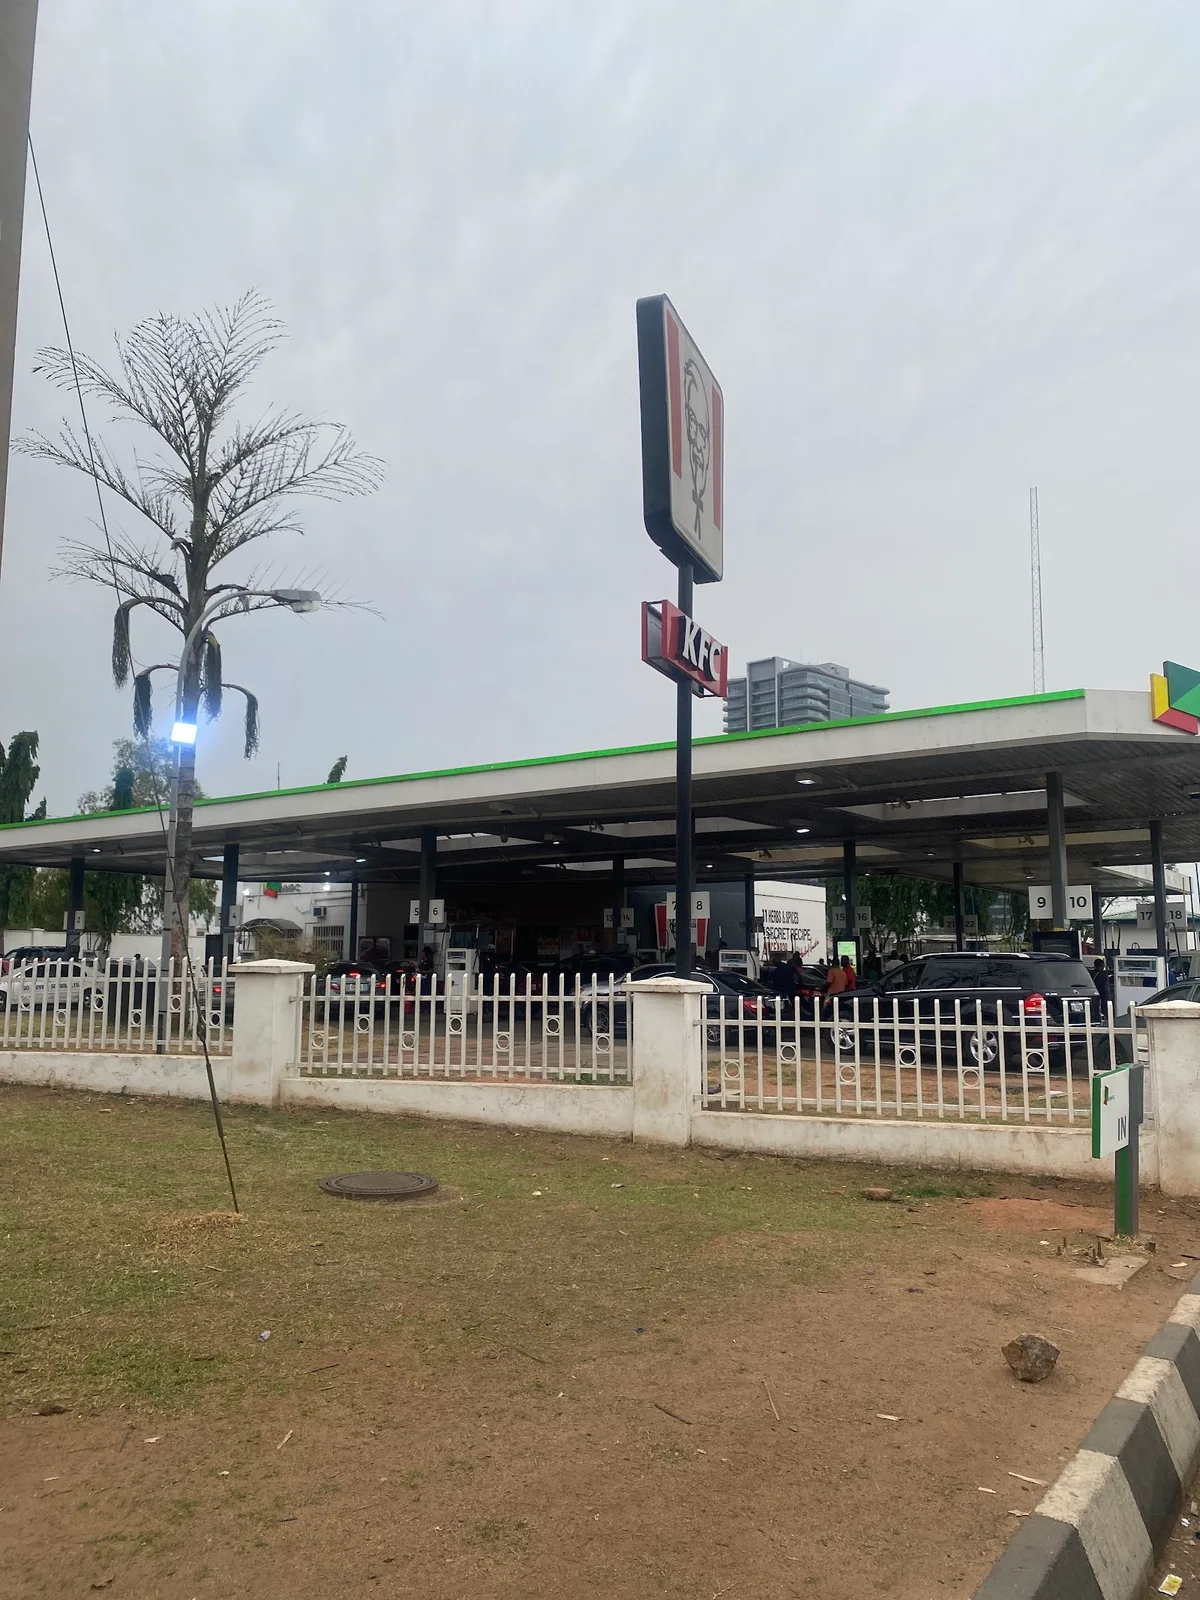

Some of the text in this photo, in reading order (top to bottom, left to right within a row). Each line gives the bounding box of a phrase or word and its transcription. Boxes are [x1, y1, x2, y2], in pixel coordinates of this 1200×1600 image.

[682, 615, 722, 682] KFC
[696, 901, 703, 910] 8
[1037, 897, 1046, 908] 9
[1070, 896, 1087, 908] 10
[414, 908, 419, 916] 5
[433, 907, 438, 916] 6
[1140, 911, 1152, 920] 17
[1169, 910, 1182, 920] 18
[768, 910, 781, 924] HERBS
[782, 911, 786, 924] &
[786, 911, 799, 924] SPICES
[857, 913, 867, 921] 16
[766, 927, 790, 940] SECRET
[1118, 1116, 1127, 1142] IN
